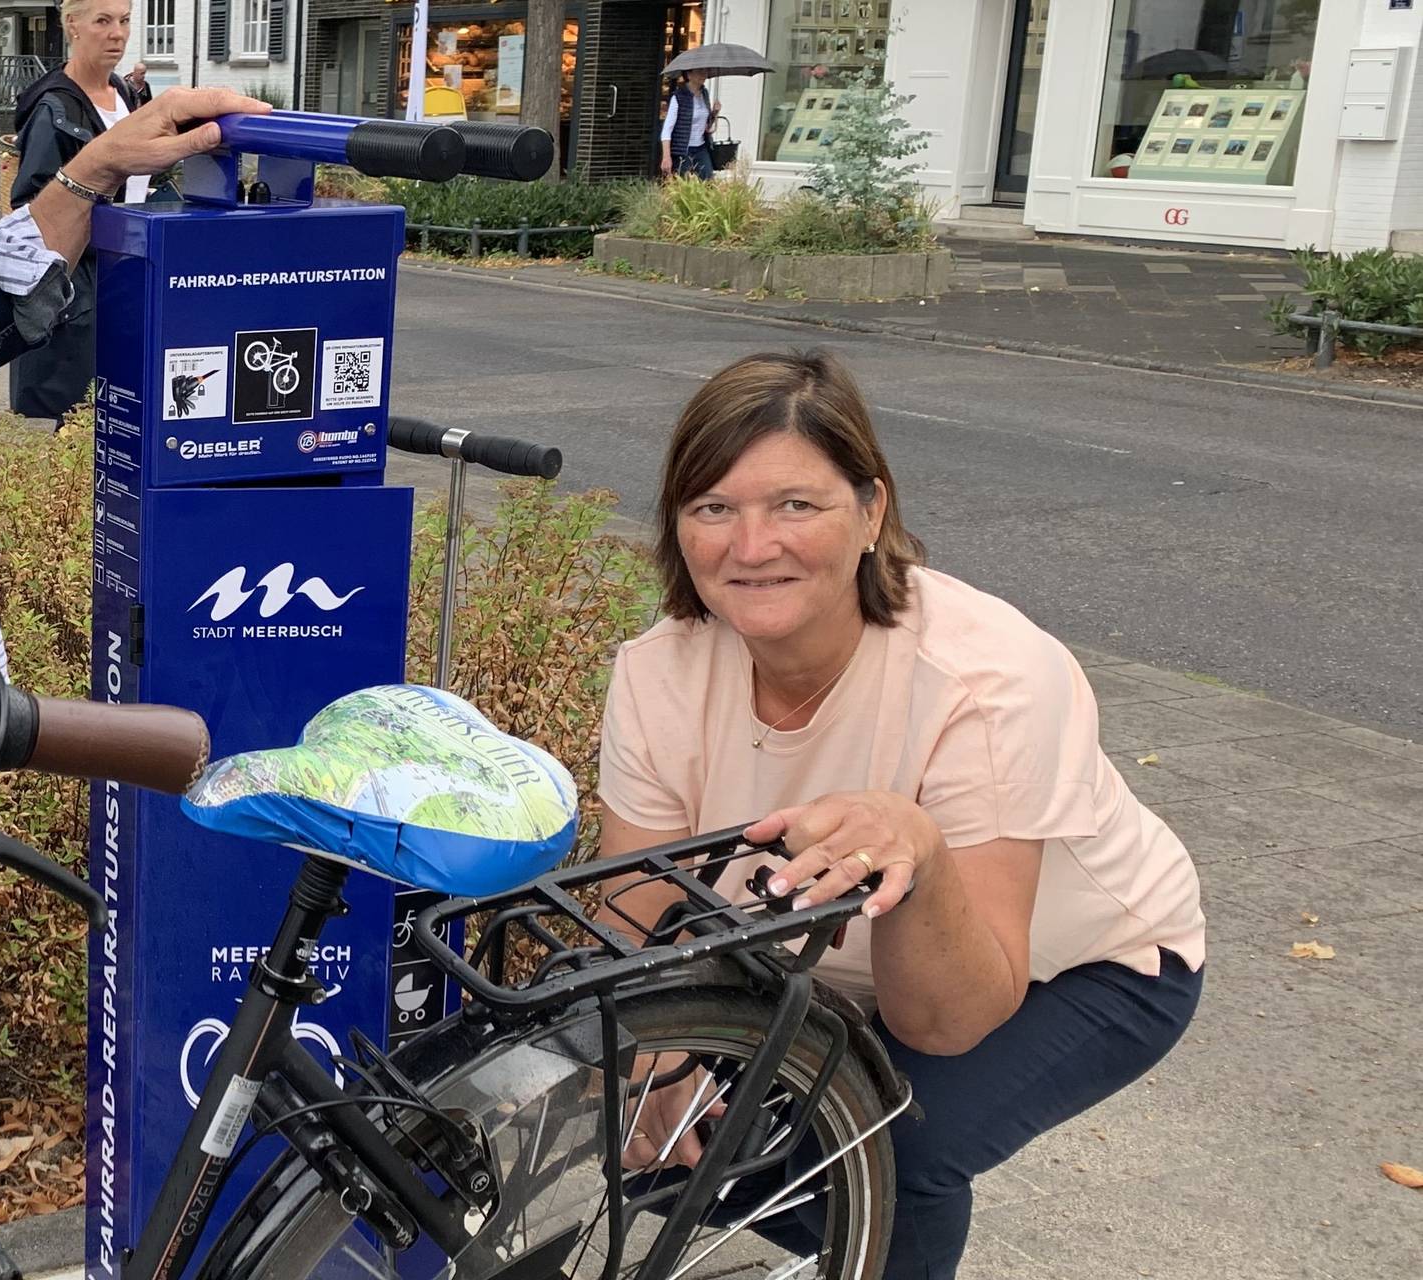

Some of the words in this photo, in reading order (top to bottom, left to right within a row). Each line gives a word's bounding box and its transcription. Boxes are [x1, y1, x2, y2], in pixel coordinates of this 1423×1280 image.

[169, 268, 386, 288] FAHRRAD-REPARATURSTATION
[180, 440, 261, 460] ZIEGLER
[193, 626, 235, 639] STADT
[242, 625, 343, 638] MEERBUSCH
[100, 630, 122, 1276] FAHRRAD-REPARATURSTON
[211, 945, 351, 963] MEESCH
[211, 965, 350, 982] RATIV
